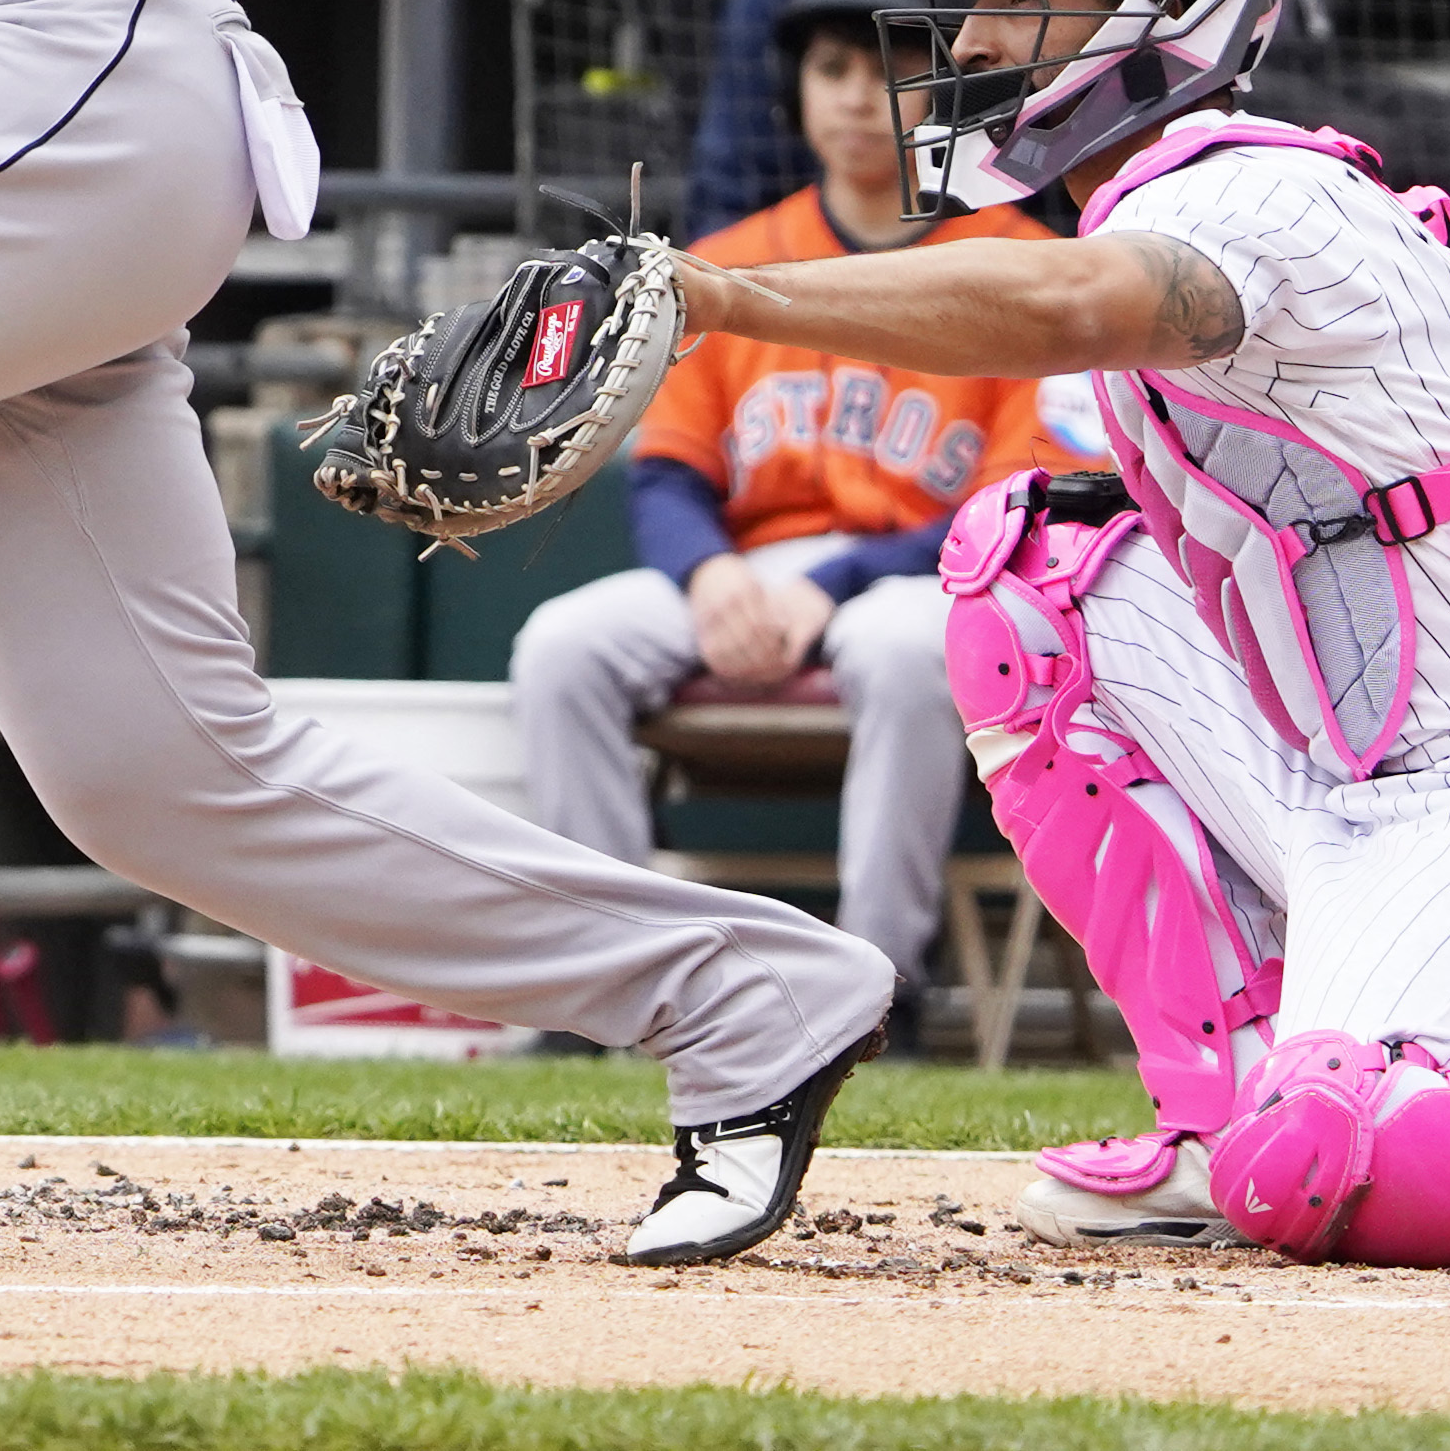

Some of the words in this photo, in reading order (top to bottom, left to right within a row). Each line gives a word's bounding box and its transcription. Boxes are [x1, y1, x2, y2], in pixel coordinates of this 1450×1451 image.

[504, 327, 528, 362] GLOVE
[536, 312, 563, 377] Rawlings
[490, 361, 509, 390] GOLD
[484, 391, 500, 414] THE
